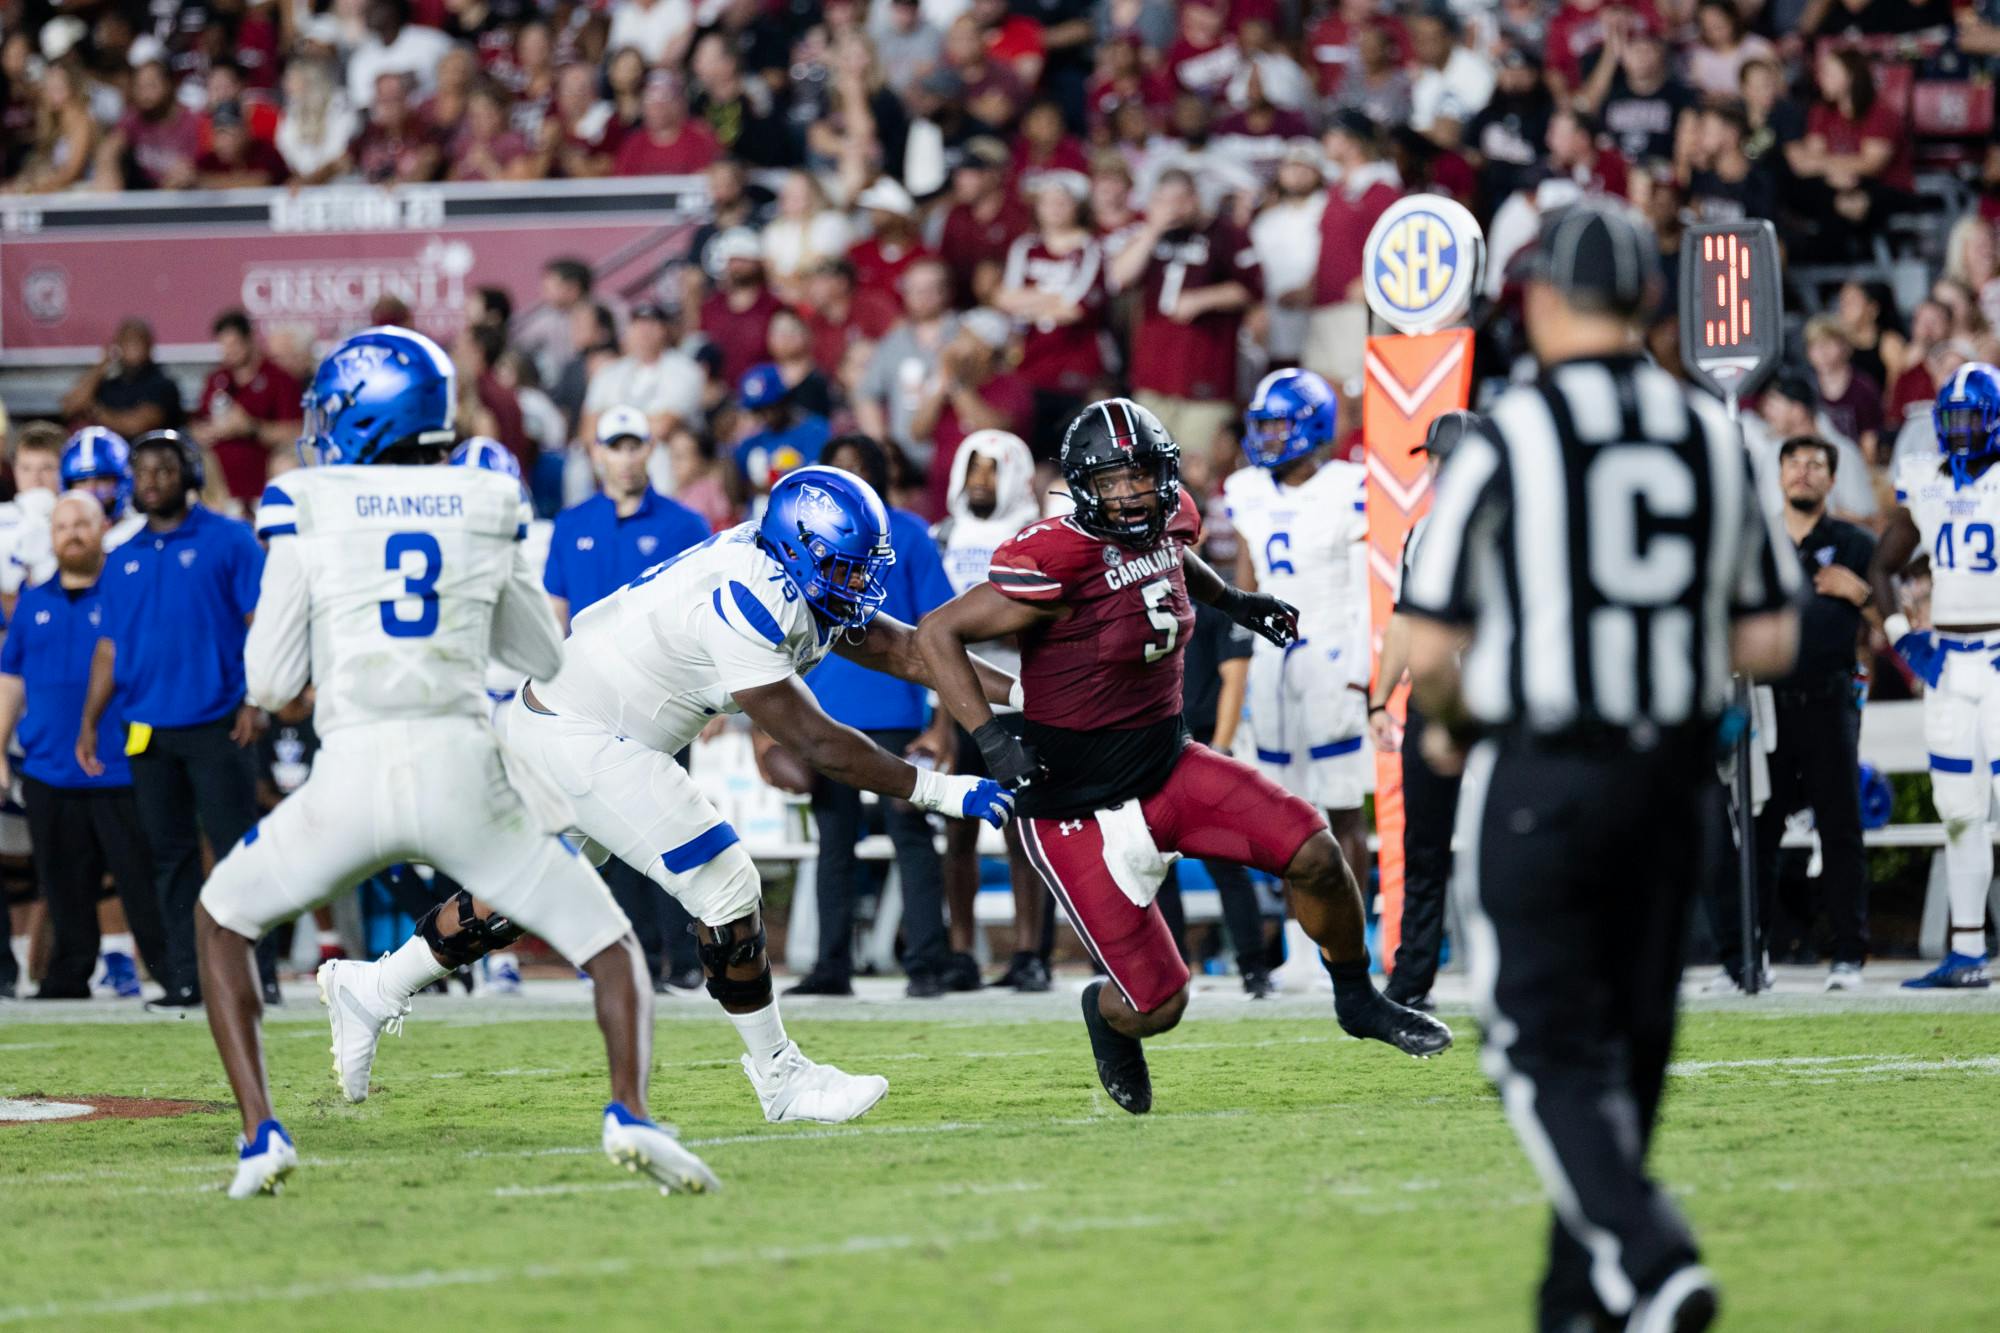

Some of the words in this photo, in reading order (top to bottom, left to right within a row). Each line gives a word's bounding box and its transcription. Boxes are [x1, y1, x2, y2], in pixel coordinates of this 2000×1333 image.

[1379, 216, 1454, 308] SEC
[356, 495, 464, 518] GRAINGER
[1584, 443, 1698, 605] C
[1935, 522, 1998, 573] 43
[380, 531, 443, 638] 3
[1104, 546, 1180, 591] CAROLINA
[1141, 577, 1179, 663] 5
